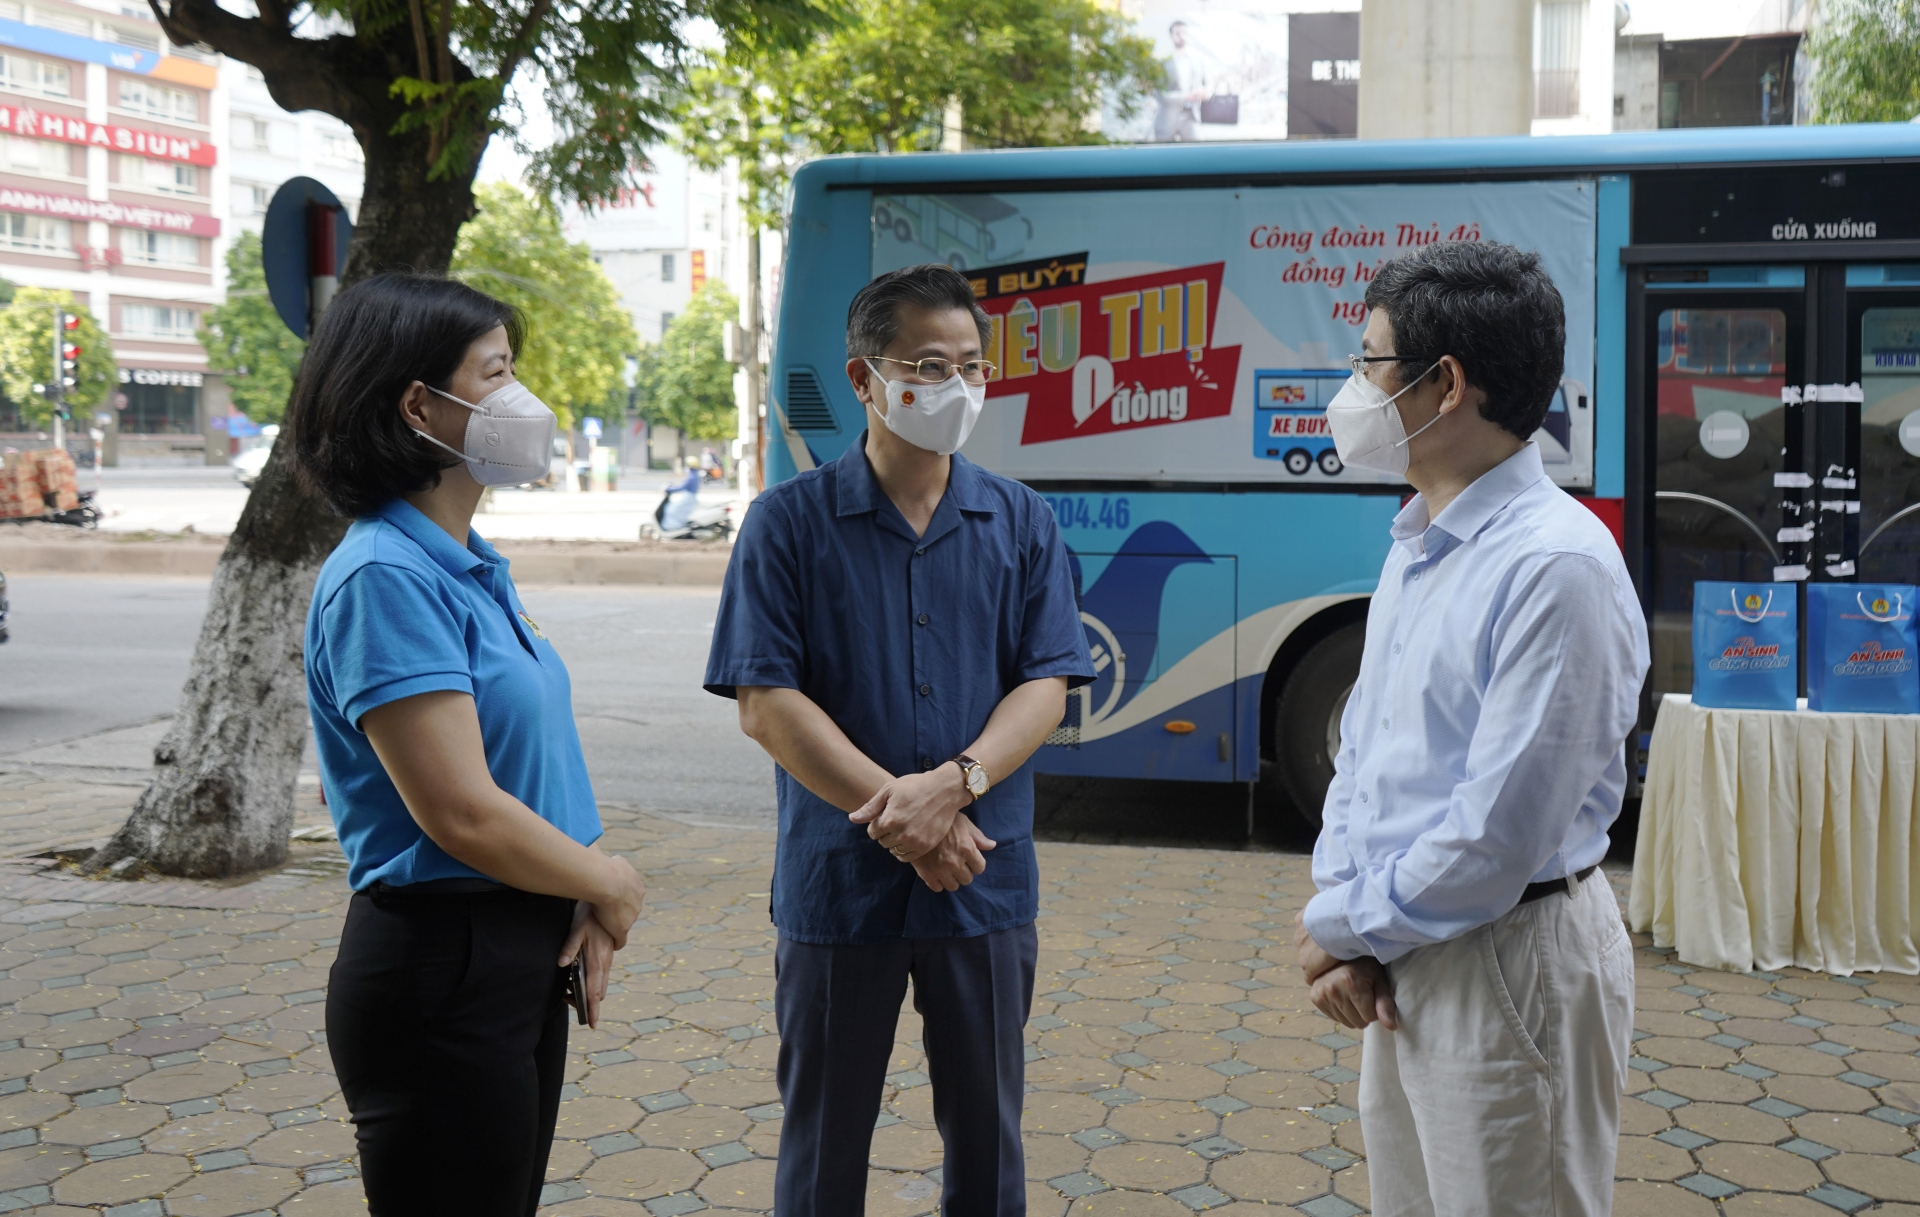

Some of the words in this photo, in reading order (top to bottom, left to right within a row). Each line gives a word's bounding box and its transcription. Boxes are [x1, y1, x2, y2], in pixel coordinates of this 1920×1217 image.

[1250, 225, 1313, 254] Công
[1321, 223, 1386, 249] đoàn
[1396, 221, 1440, 248] Thủ
[1771, 217, 1809, 240] CỬA
[1814, 217, 1877, 240] XUỐNG
[998, 260, 1086, 295] BUÝT
[1281, 257, 1346, 289] đồng
[1100, 280, 1208, 363] THỊ
[132, 368, 204, 387] COFFEE
[1110, 380, 1189, 426] đồng
[1272, 416, 1293, 435] XE
[1722, 645, 1745, 658] AN
[1746, 644, 1779, 658] SINH
[1847, 650, 1871, 663] AN
[1872, 648, 1906, 662] SINH
